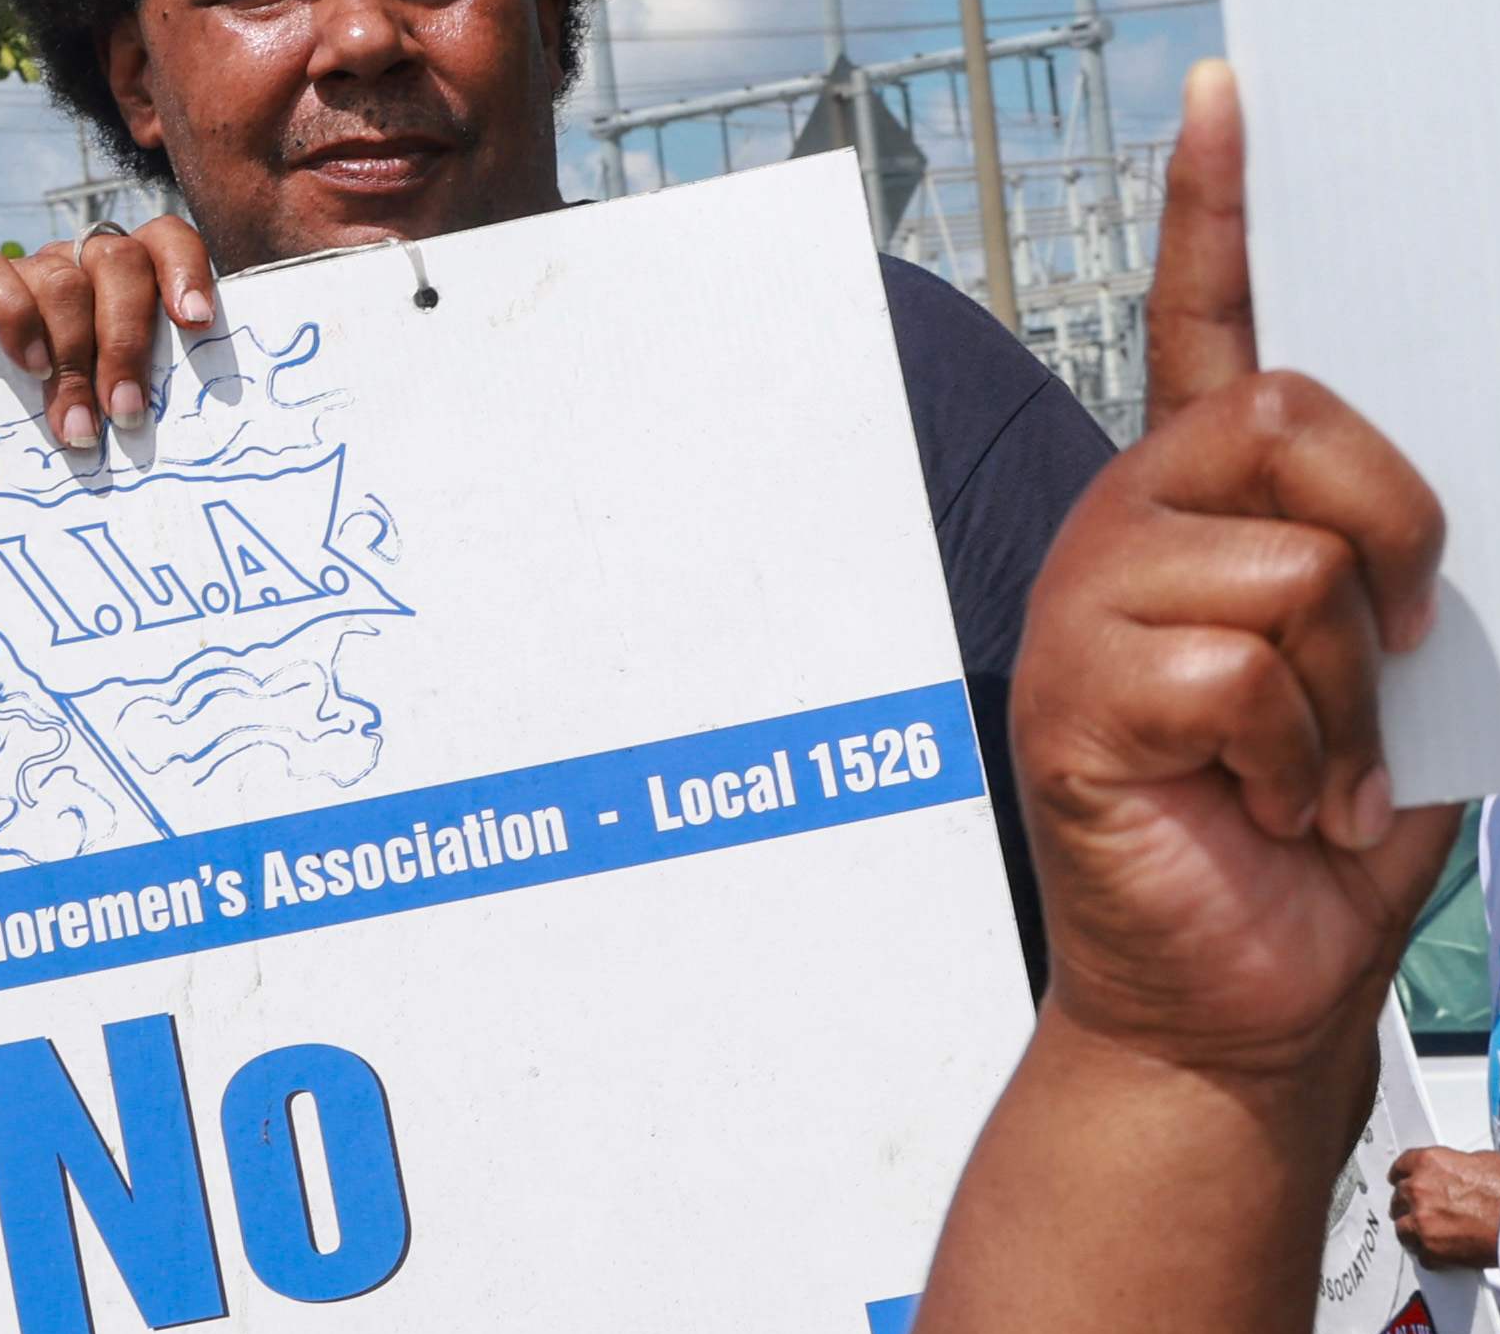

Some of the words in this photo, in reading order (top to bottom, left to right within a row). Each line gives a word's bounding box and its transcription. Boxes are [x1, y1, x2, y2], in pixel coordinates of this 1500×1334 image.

[262, 805, 568, 912] Association
[647, 750, 797, 834] Local
[808, 721, 942, 801] 1526
